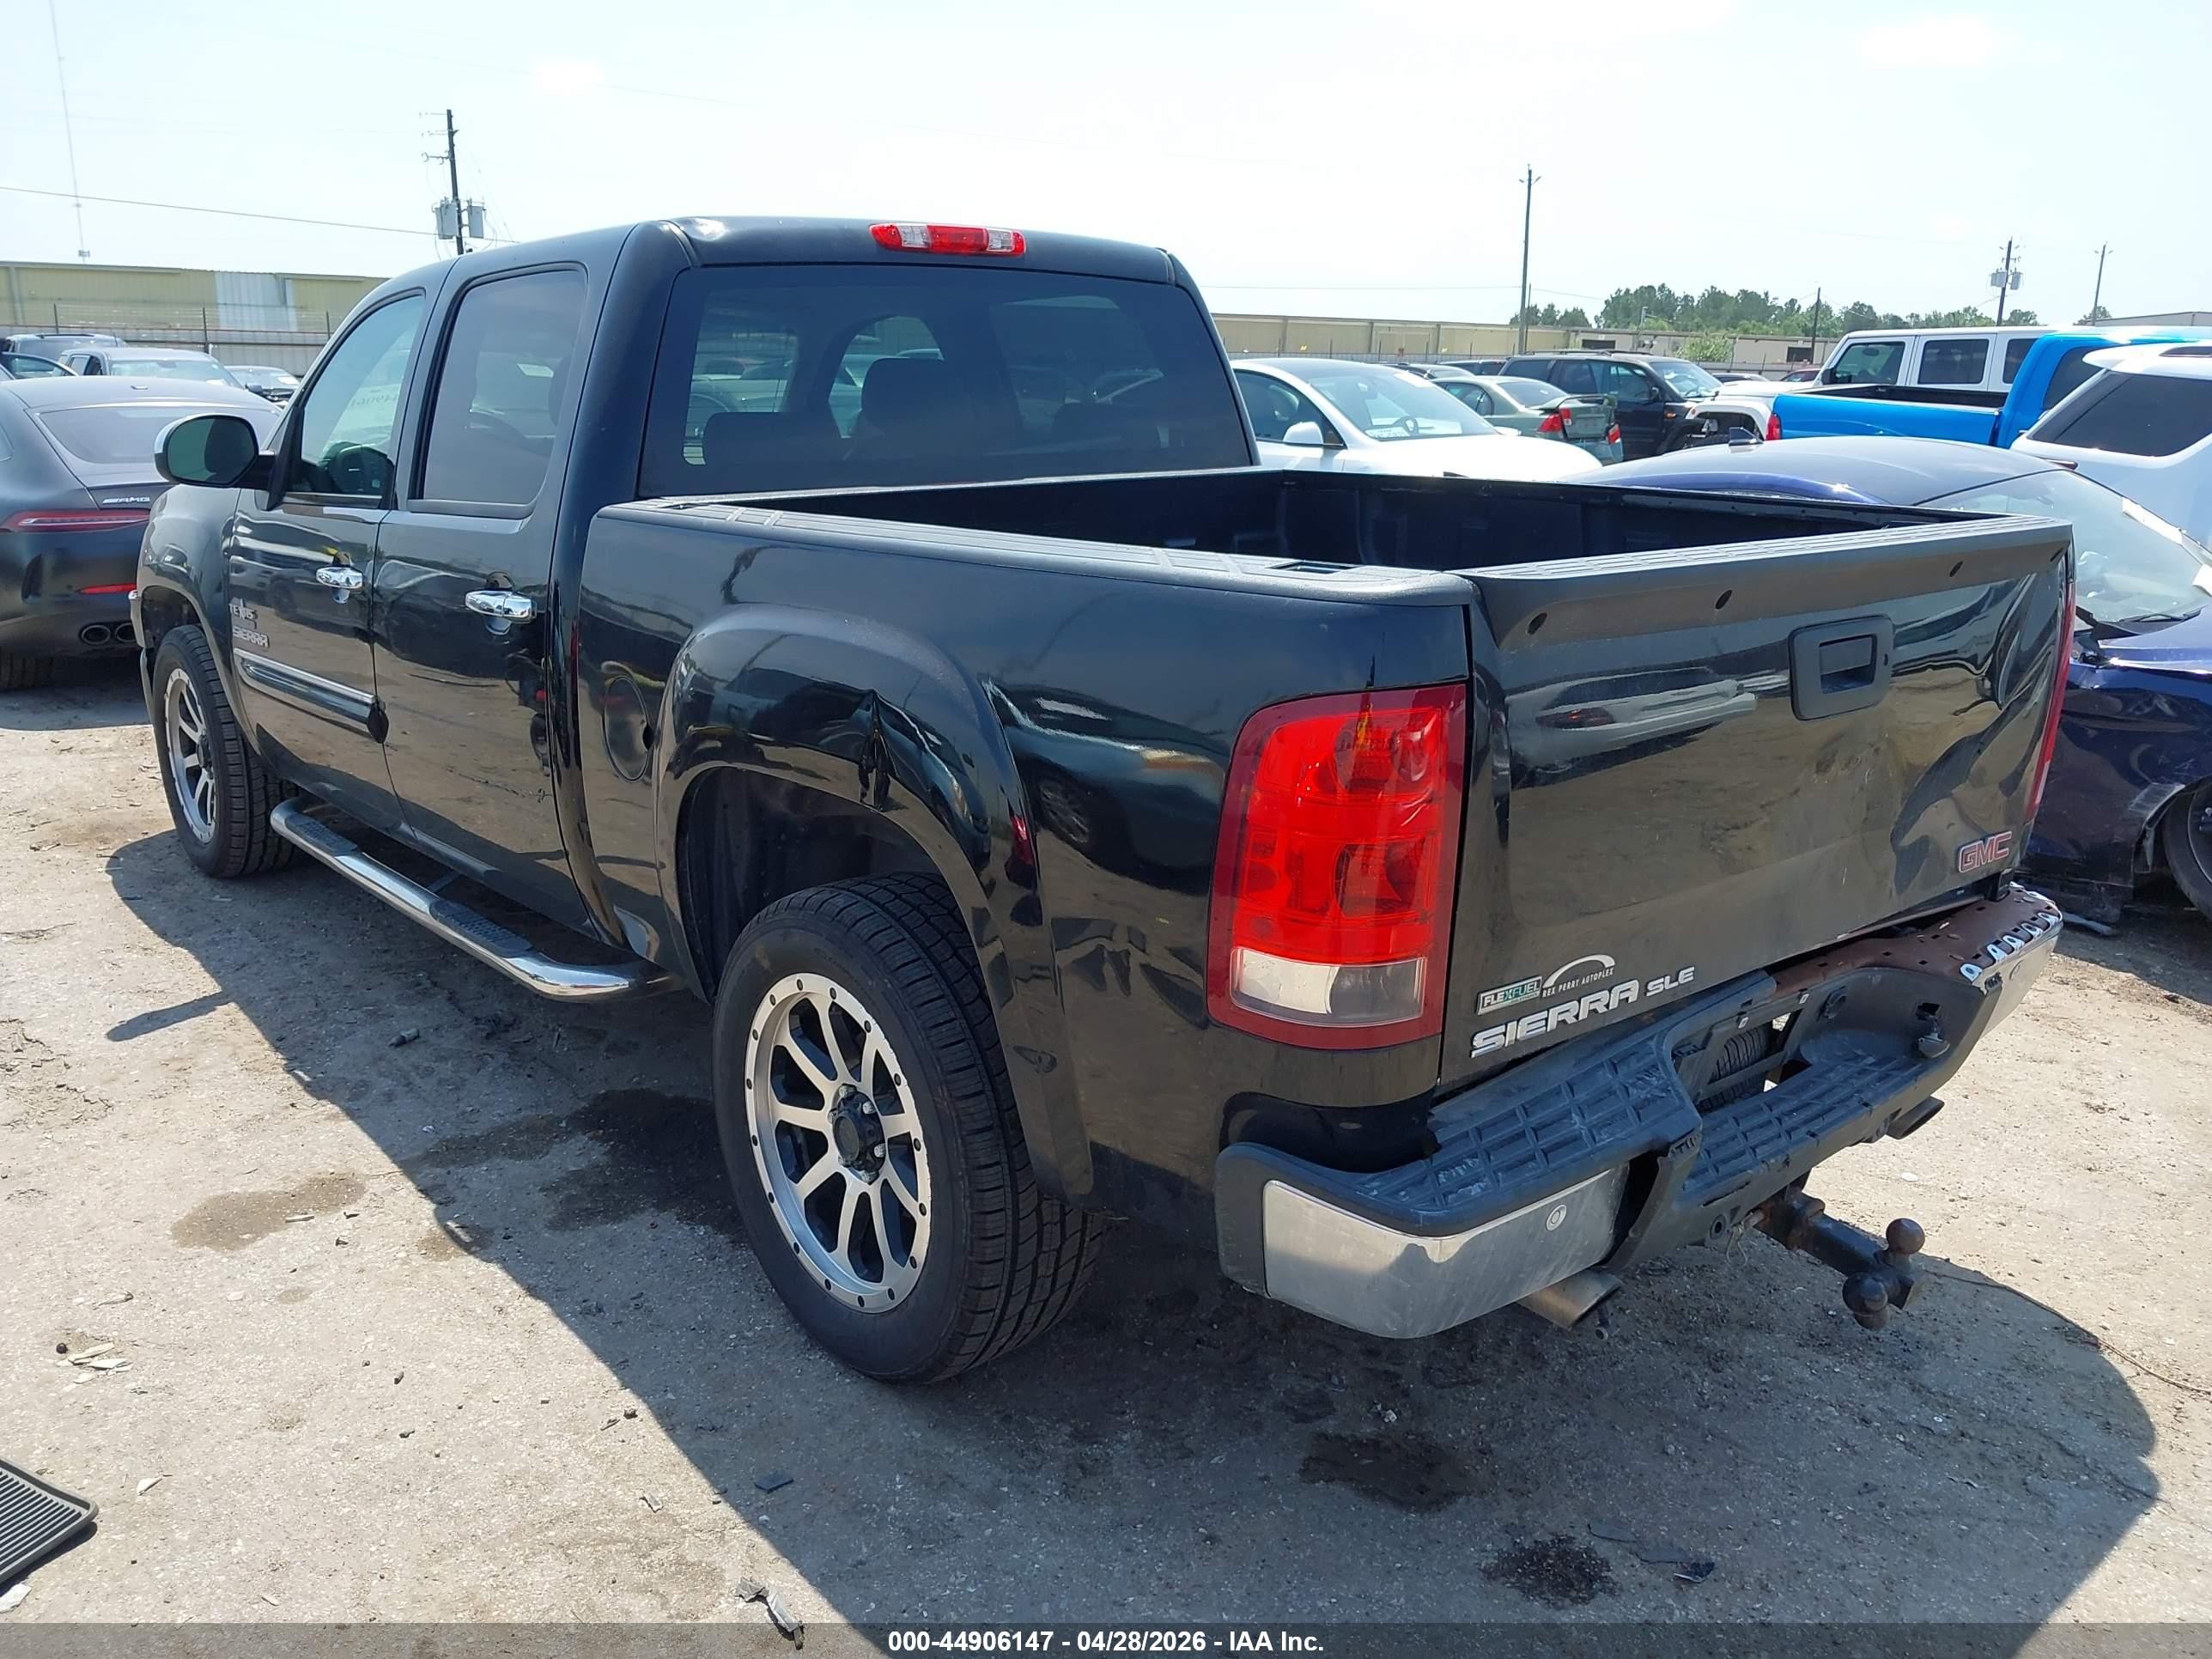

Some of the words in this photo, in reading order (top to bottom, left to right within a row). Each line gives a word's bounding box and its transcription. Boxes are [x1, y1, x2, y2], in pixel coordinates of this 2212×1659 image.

[233, 625, 269, 647] SIERRA
[1959, 830, 2013, 873] GMC
[1483, 981, 1540, 1007] FLEXFUEL
[1542, 986, 1556, 998] REX
[1558, 978, 1580, 993] PERRY
[1581, 967, 1614, 985] AUTOPLEX
[1471, 979, 1639, 1058] SIERRA
[1645, 966, 1695, 997] SLE
